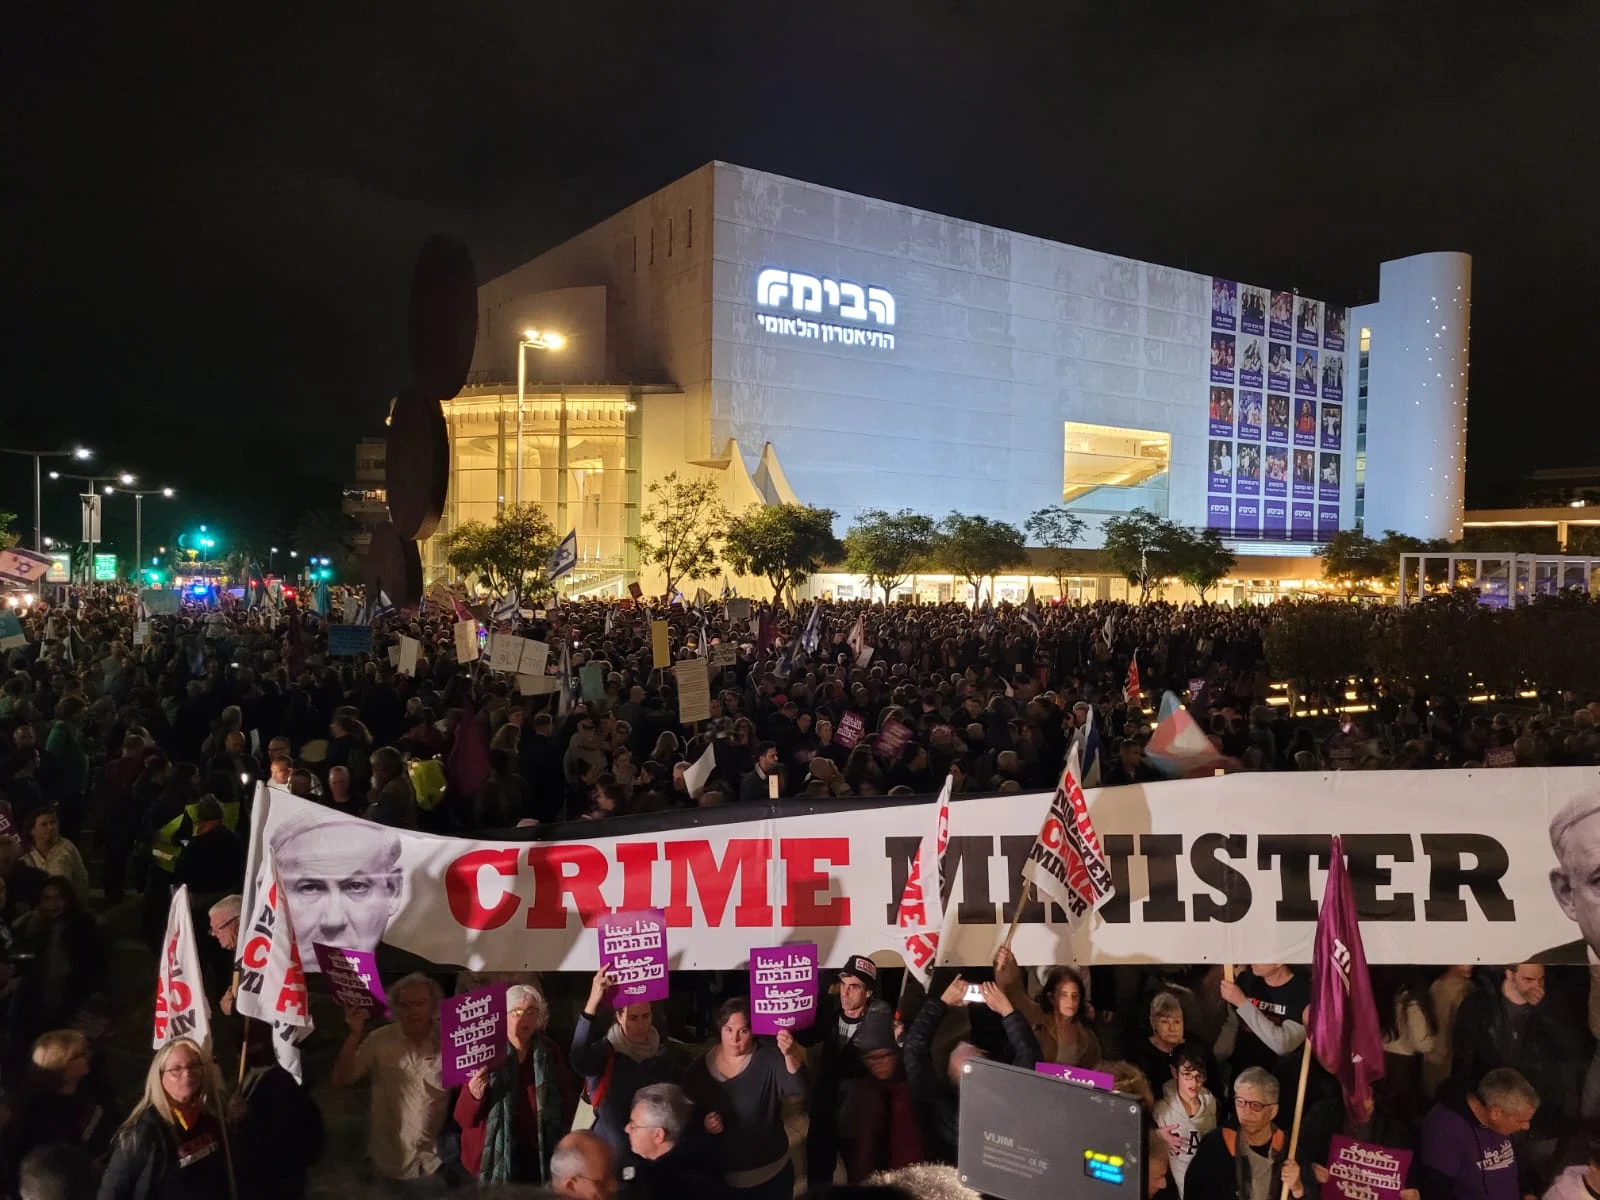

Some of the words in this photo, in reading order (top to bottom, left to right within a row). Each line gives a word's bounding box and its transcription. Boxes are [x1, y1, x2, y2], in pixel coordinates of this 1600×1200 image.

[757, 314, 819, 339] הלאומי
[822, 324, 895, 350] התיאטרון
[445, 837, 851, 930] CRIME
[605, 923, 633, 938] بيتنا
[636, 920, 660, 933] هذا
[606, 938, 641, 951] הבית
[644, 935, 660, 946] זה
[756, 956, 785, 971] بيتنا
[787, 954, 812, 968] هذا
[642, 966, 661, 978] של
[758, 971, 792, 982] הבית
[794, 969, 810, 979] זה
[462, 1003, 486, 1018] דיור
[757, 1000, 789, 1012] כולנו
[791, 997, 811, 1010] של
[456, 1025, 494, 1044] פרנסה
[458, 1049, 494, 1067] תקווה
[983, 1131, 1014, 1148] VIJIM
[1342, 1149, 1397, 1170] ממשלת
[1332, 1166, 1399, 1189] המתנחלים
